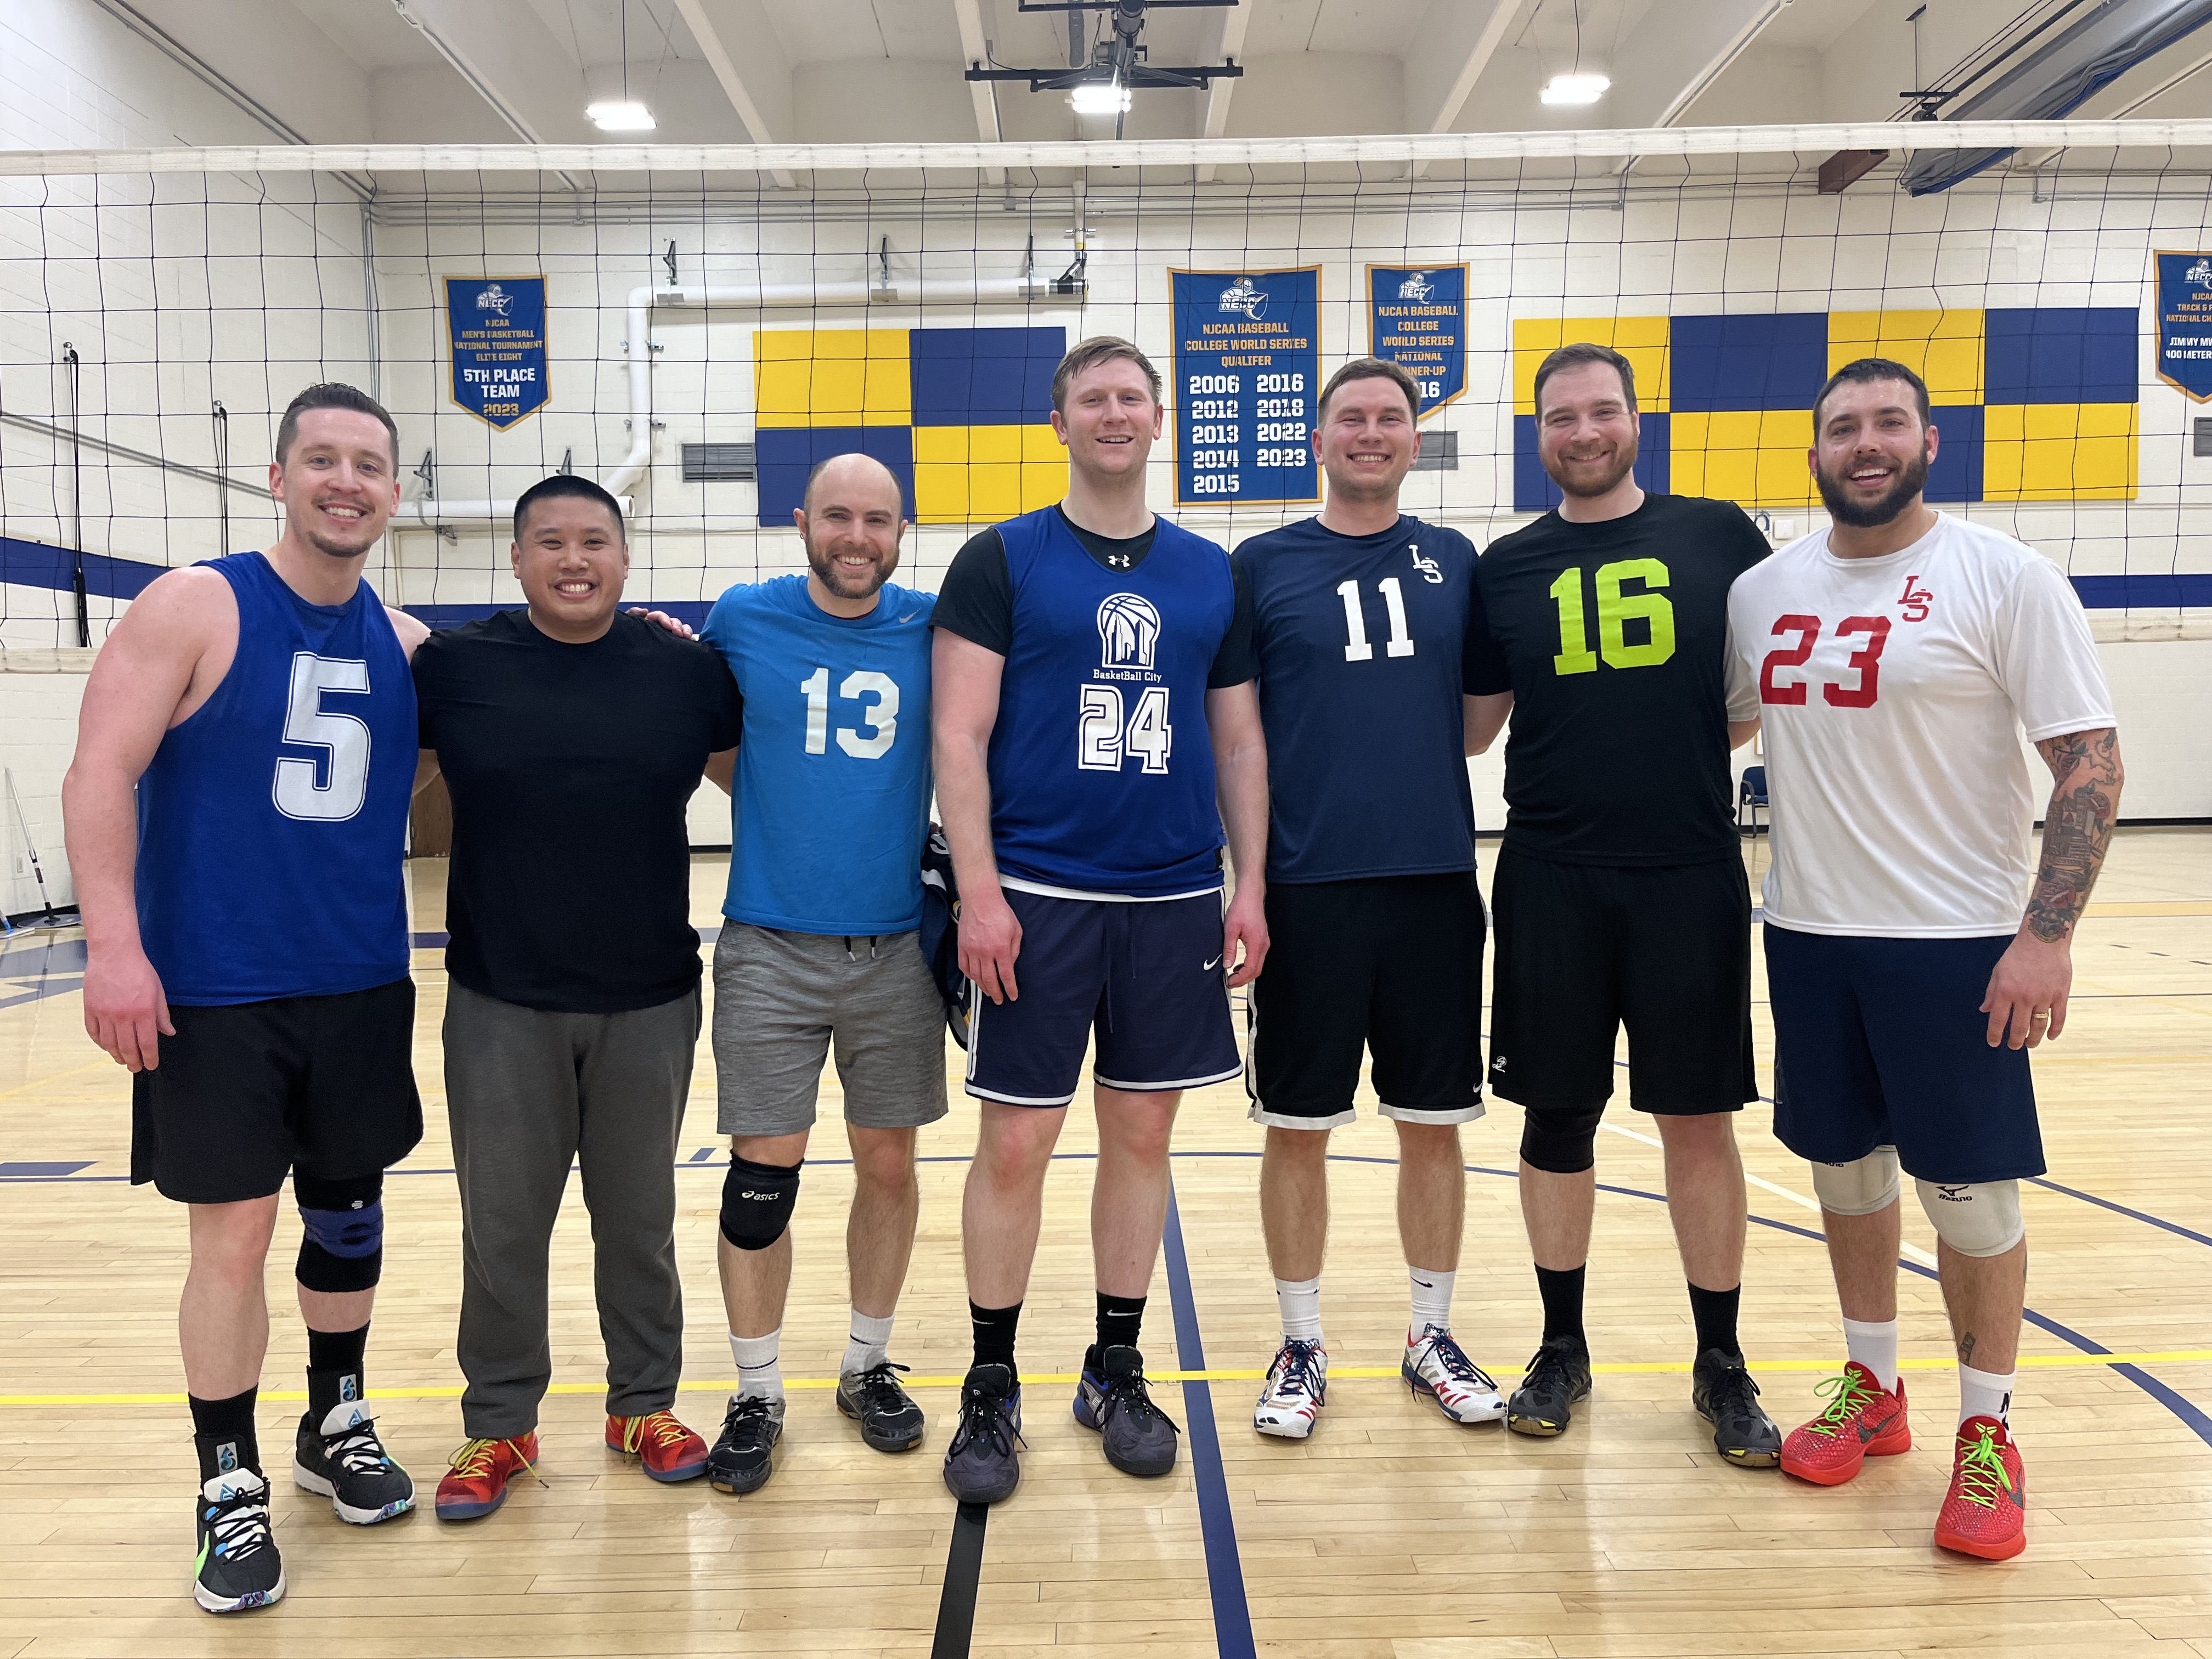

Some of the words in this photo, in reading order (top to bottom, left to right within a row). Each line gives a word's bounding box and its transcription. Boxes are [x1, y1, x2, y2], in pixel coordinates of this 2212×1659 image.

[1401, 288, 1425, 296] NECC
[478, 299, 504, 308] NECC
[1221, 298, 1256, 309] NECC
[2177, 303, 2200, 312] TRACK
[1379, 306, 1409, 317] NJCAA
[1410, 306, 1458, 316] BASEBALL
[485, 319, 510, 328] NJCAA
[2166, 314, 2201, 323] NATIONAL
[1203, 324, 1236, 335] NJCAA
[1238, 323, 1289, 334] BASEBALL
[1398, 321, 1438, 331] COLLEGE
[487, 330, 535, 338] BASKETBALL
[454, 342, 491, 351] NATIONAL
[492, 340, 543, 350] TOURNAMENT
[1185, 340, 1228, 351] COLLEGE
[1231, 339, 1267, 350] WORLD
[1269, 338, 1307, 349] SERIES
[1383, 336, 1417, 347] WORLD
[1419, 336, 1454, 346] SERIES
[2169, 337, 2199, 346] JIMMY
[476, 353, 498, 362] ELITE
[499, 353, 522, 361] EIGHT
[1395, 352, 1443, 362] NATIONAL
[2165, 350, 2182, 359] 400
[1221, 356, 1272, 368] QUALIFER
[464, 369, 490, 383] 5TH
[494, 368, 536, 382] PLACE
[1401, 366, 1447, 376] NNER-UP
[1189, 375, 1240, 394] 2006
[1256, 374, 1304, 393] 2016
[1419, 382, 1440, 398] 16
[481, 385, 520, 398] TEAM
[483, 403, 519, 416] 2023
[1192, 400, 1238, 420] 2012
[1257, 398, 1304, 418] 2018
[1192, 425, 1239, 444] 2013
[1257, 423, 1306, 442] 2022
[1193, 449, 1239, 469] 2014
[1257, 448, 1306, 467] 2023
[1193, 475, 1239, 494] 2015
[1336, 578, 1414, 662] 11
[1550, 558, 1675, 676] 16
[1759, 614, 1892, 709] 23
[1093, 669, 1142, 681] BasketBall
[1144, 672, 1162, 684] City
[800, 668, 900, 759] 13
[1078, 684, 1172, 774] 24
[272, 651, 371, 822] 5
